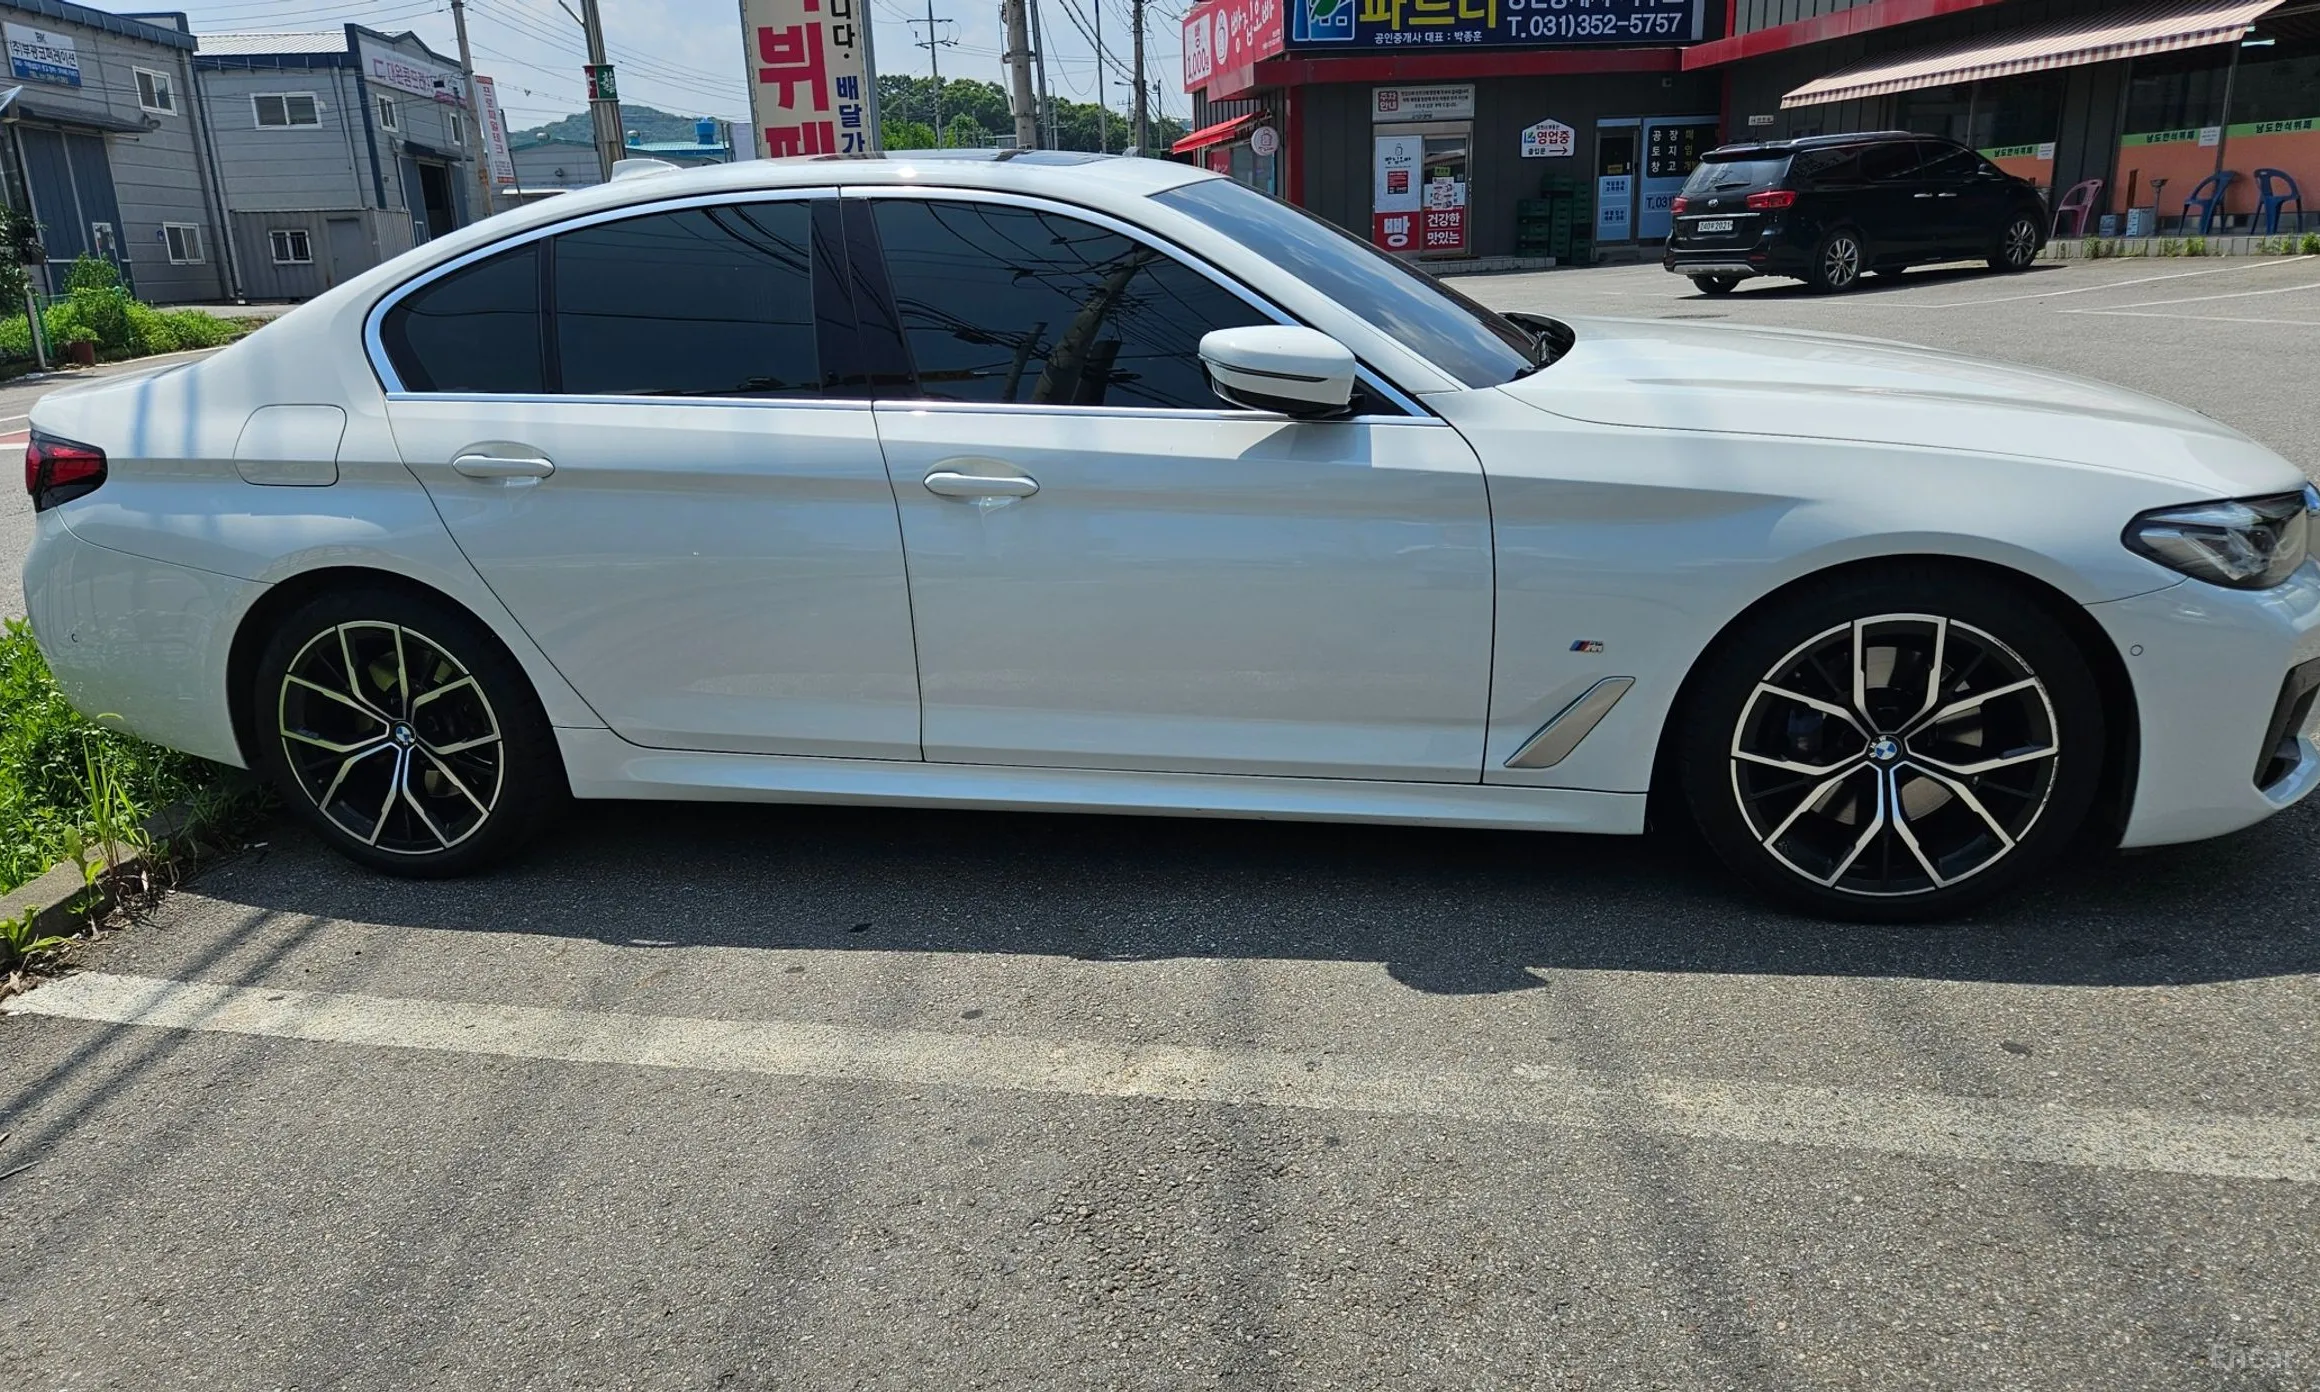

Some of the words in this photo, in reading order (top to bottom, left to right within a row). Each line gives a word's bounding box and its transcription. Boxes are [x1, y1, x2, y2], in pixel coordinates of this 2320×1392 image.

[1374, 32, 1422, 44] 공인중개사
[1425, 32, 1443, 42] 대표
[1453, 31, 1483, 43] 박종훈
[757, 0, 837, 158] 뷔페
[1380, 92, 1397, 101] 주차
[1380, 101, 1397, 110] 안내
[1536, 130, 1571, 145] 영업중
[1646, 195, 1675, 210] T.031
[1427, 212, 1460, 227] 건강한
[1383, 215, 1411, 248] 빵
[1427, 231, 1460, 246] 맛있는
